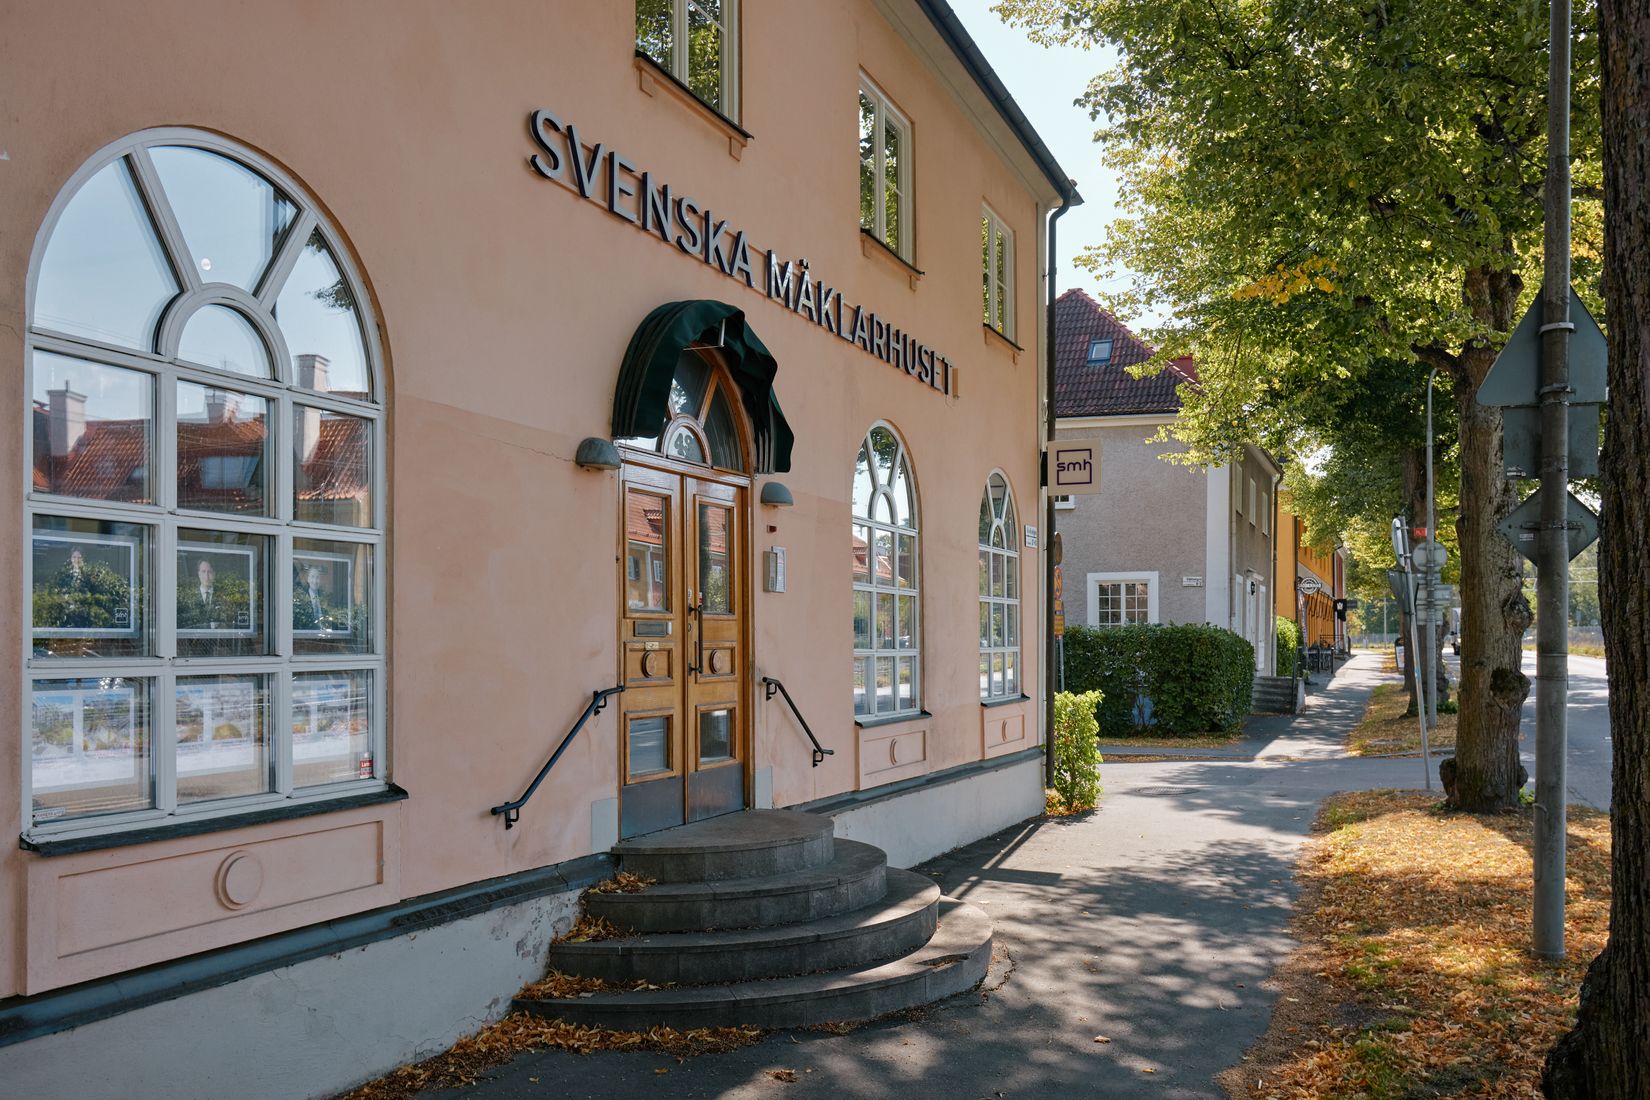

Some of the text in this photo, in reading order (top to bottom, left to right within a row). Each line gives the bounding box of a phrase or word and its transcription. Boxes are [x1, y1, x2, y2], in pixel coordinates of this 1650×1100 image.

[529, 109, 955, 396] SVENSKA MÄKLARHUSET
[1056, 458, 1093, 472] smh
